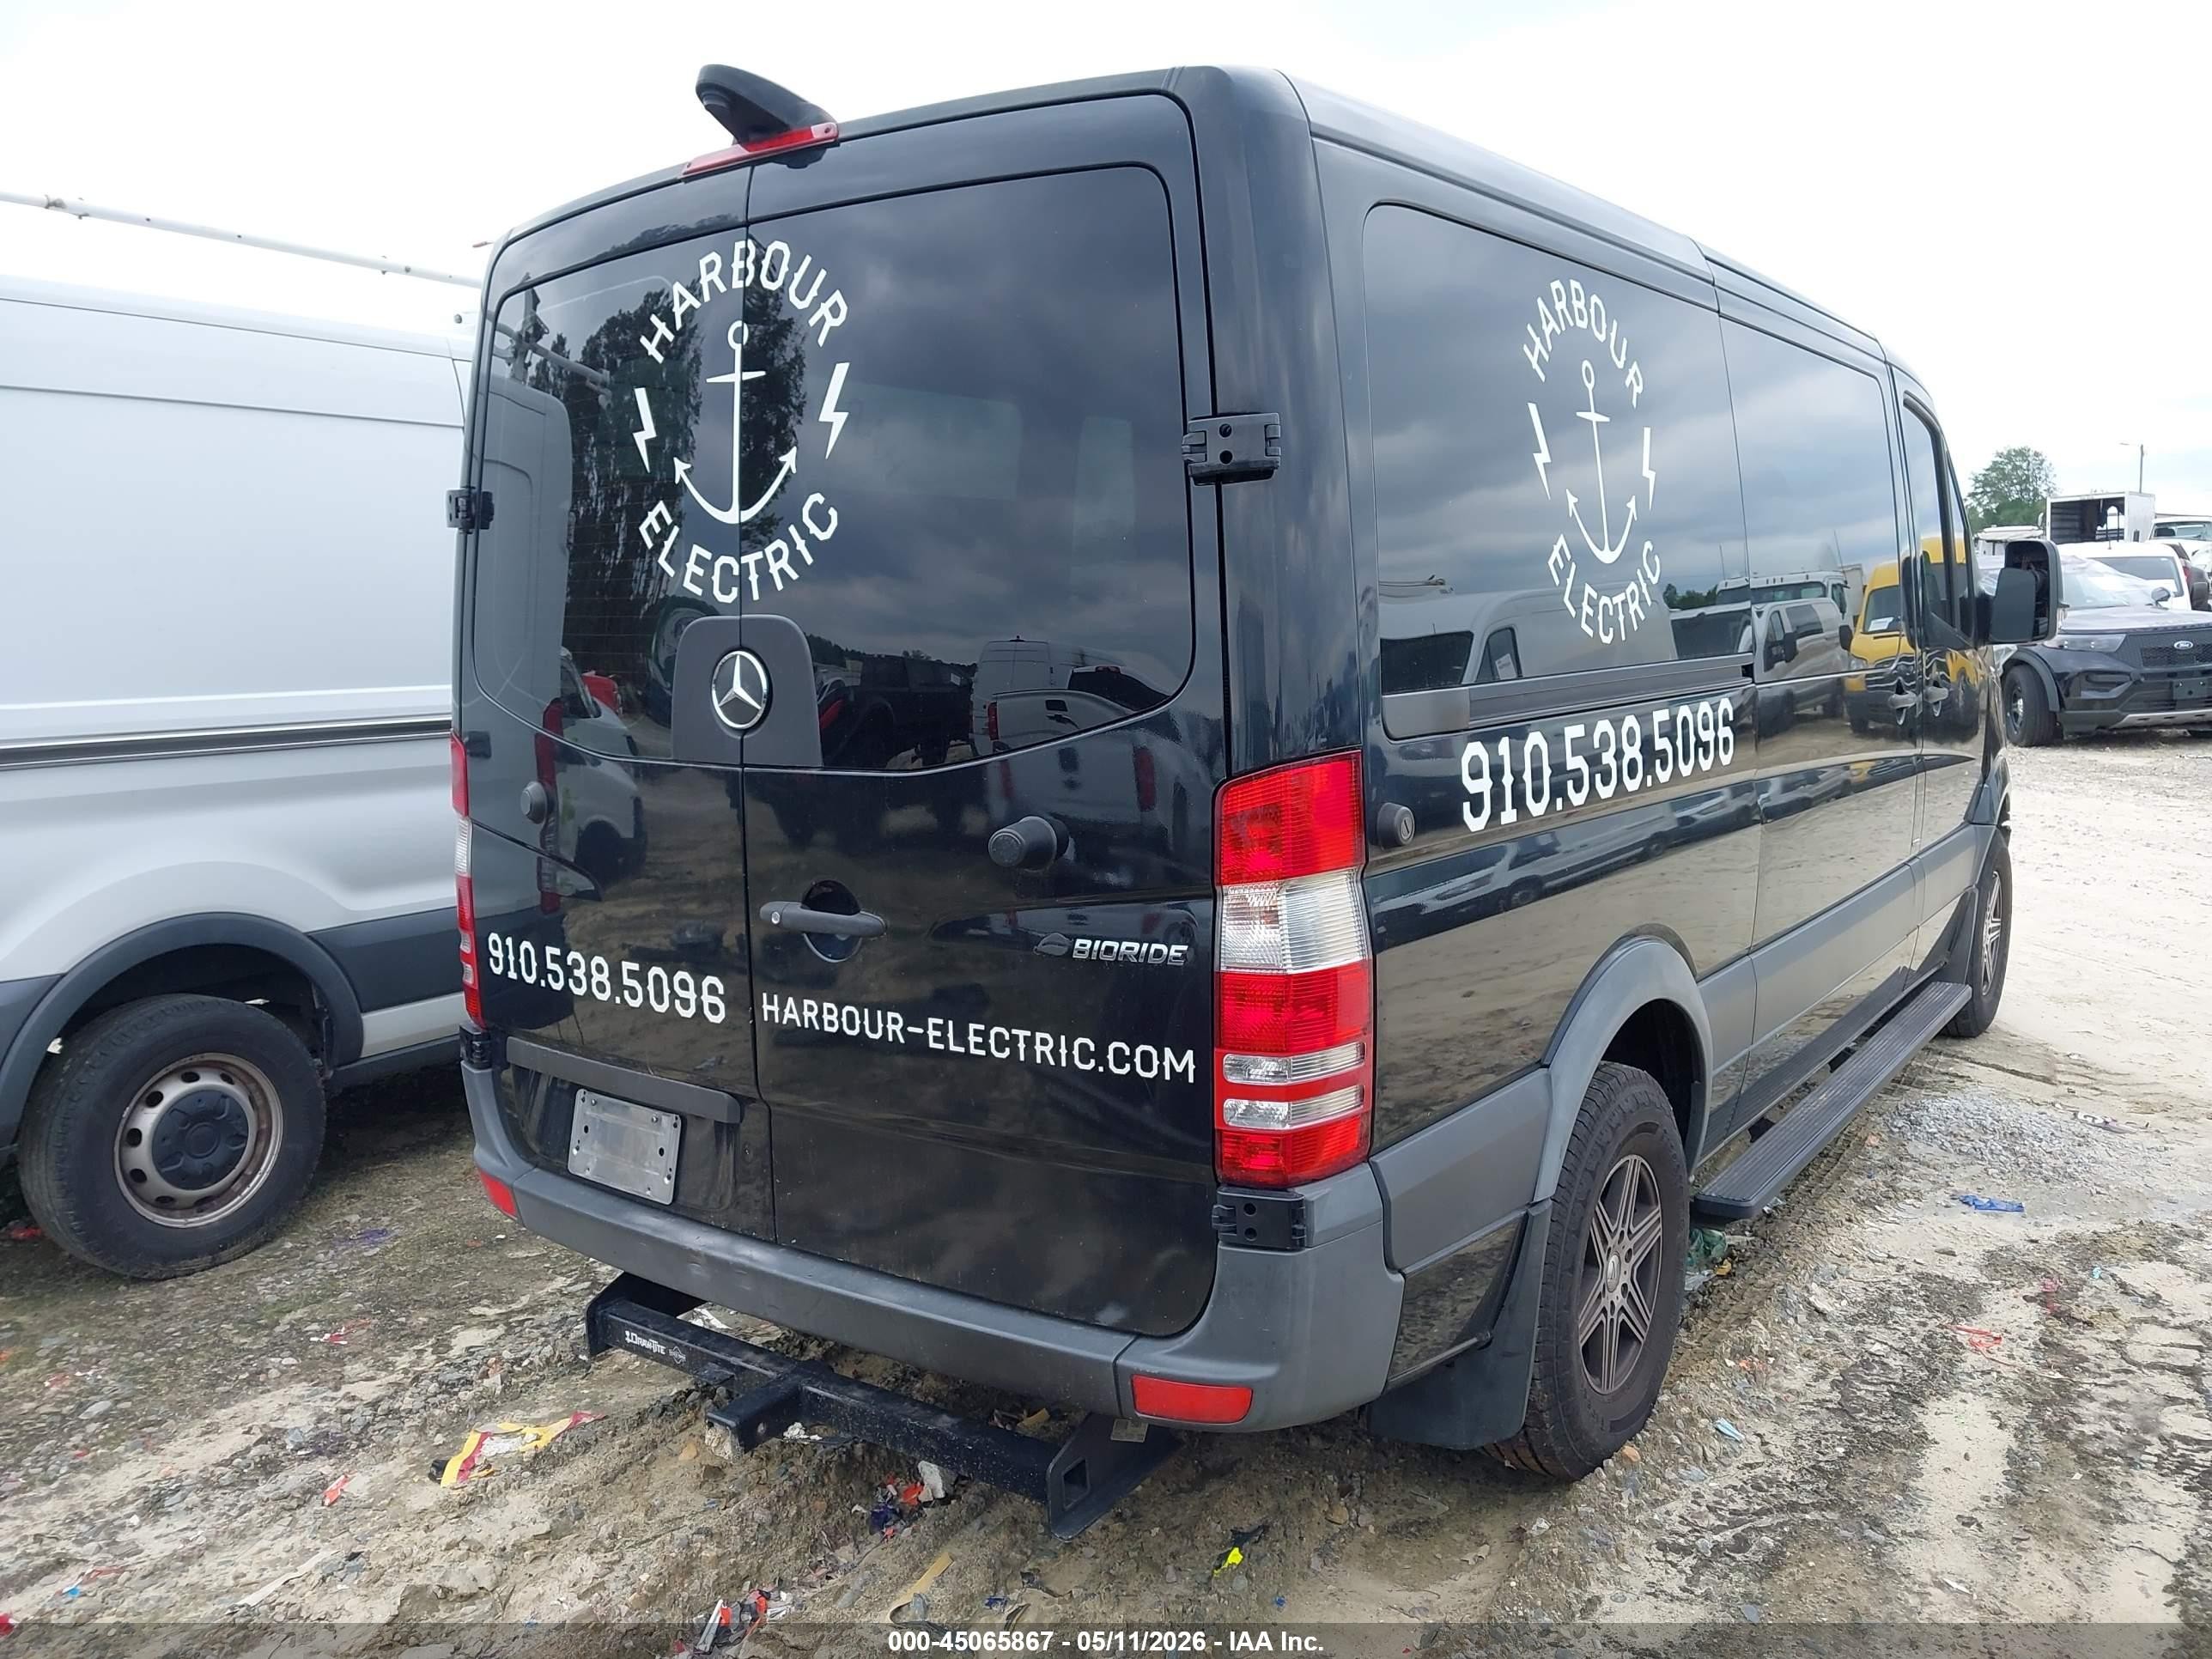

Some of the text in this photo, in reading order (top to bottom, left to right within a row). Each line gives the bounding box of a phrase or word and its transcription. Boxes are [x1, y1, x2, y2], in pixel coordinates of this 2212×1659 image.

[640, 240, 848, 364] HARBOUR
[1523, 279, 1644, 409] HARBOUR
[639, 492, 838, 604] ELECTRIC
[1547, 534, 1662, 644] ELECTRIC
[1461, 697, 1734, 832] 910.538.5096
[487, 933, 726, 1024] 910.538.5096
[1073, 939, 1188, 966] BIORIDE
[762, 993, 1196, 1084] HARBOUR-ELECTRIC.COM
